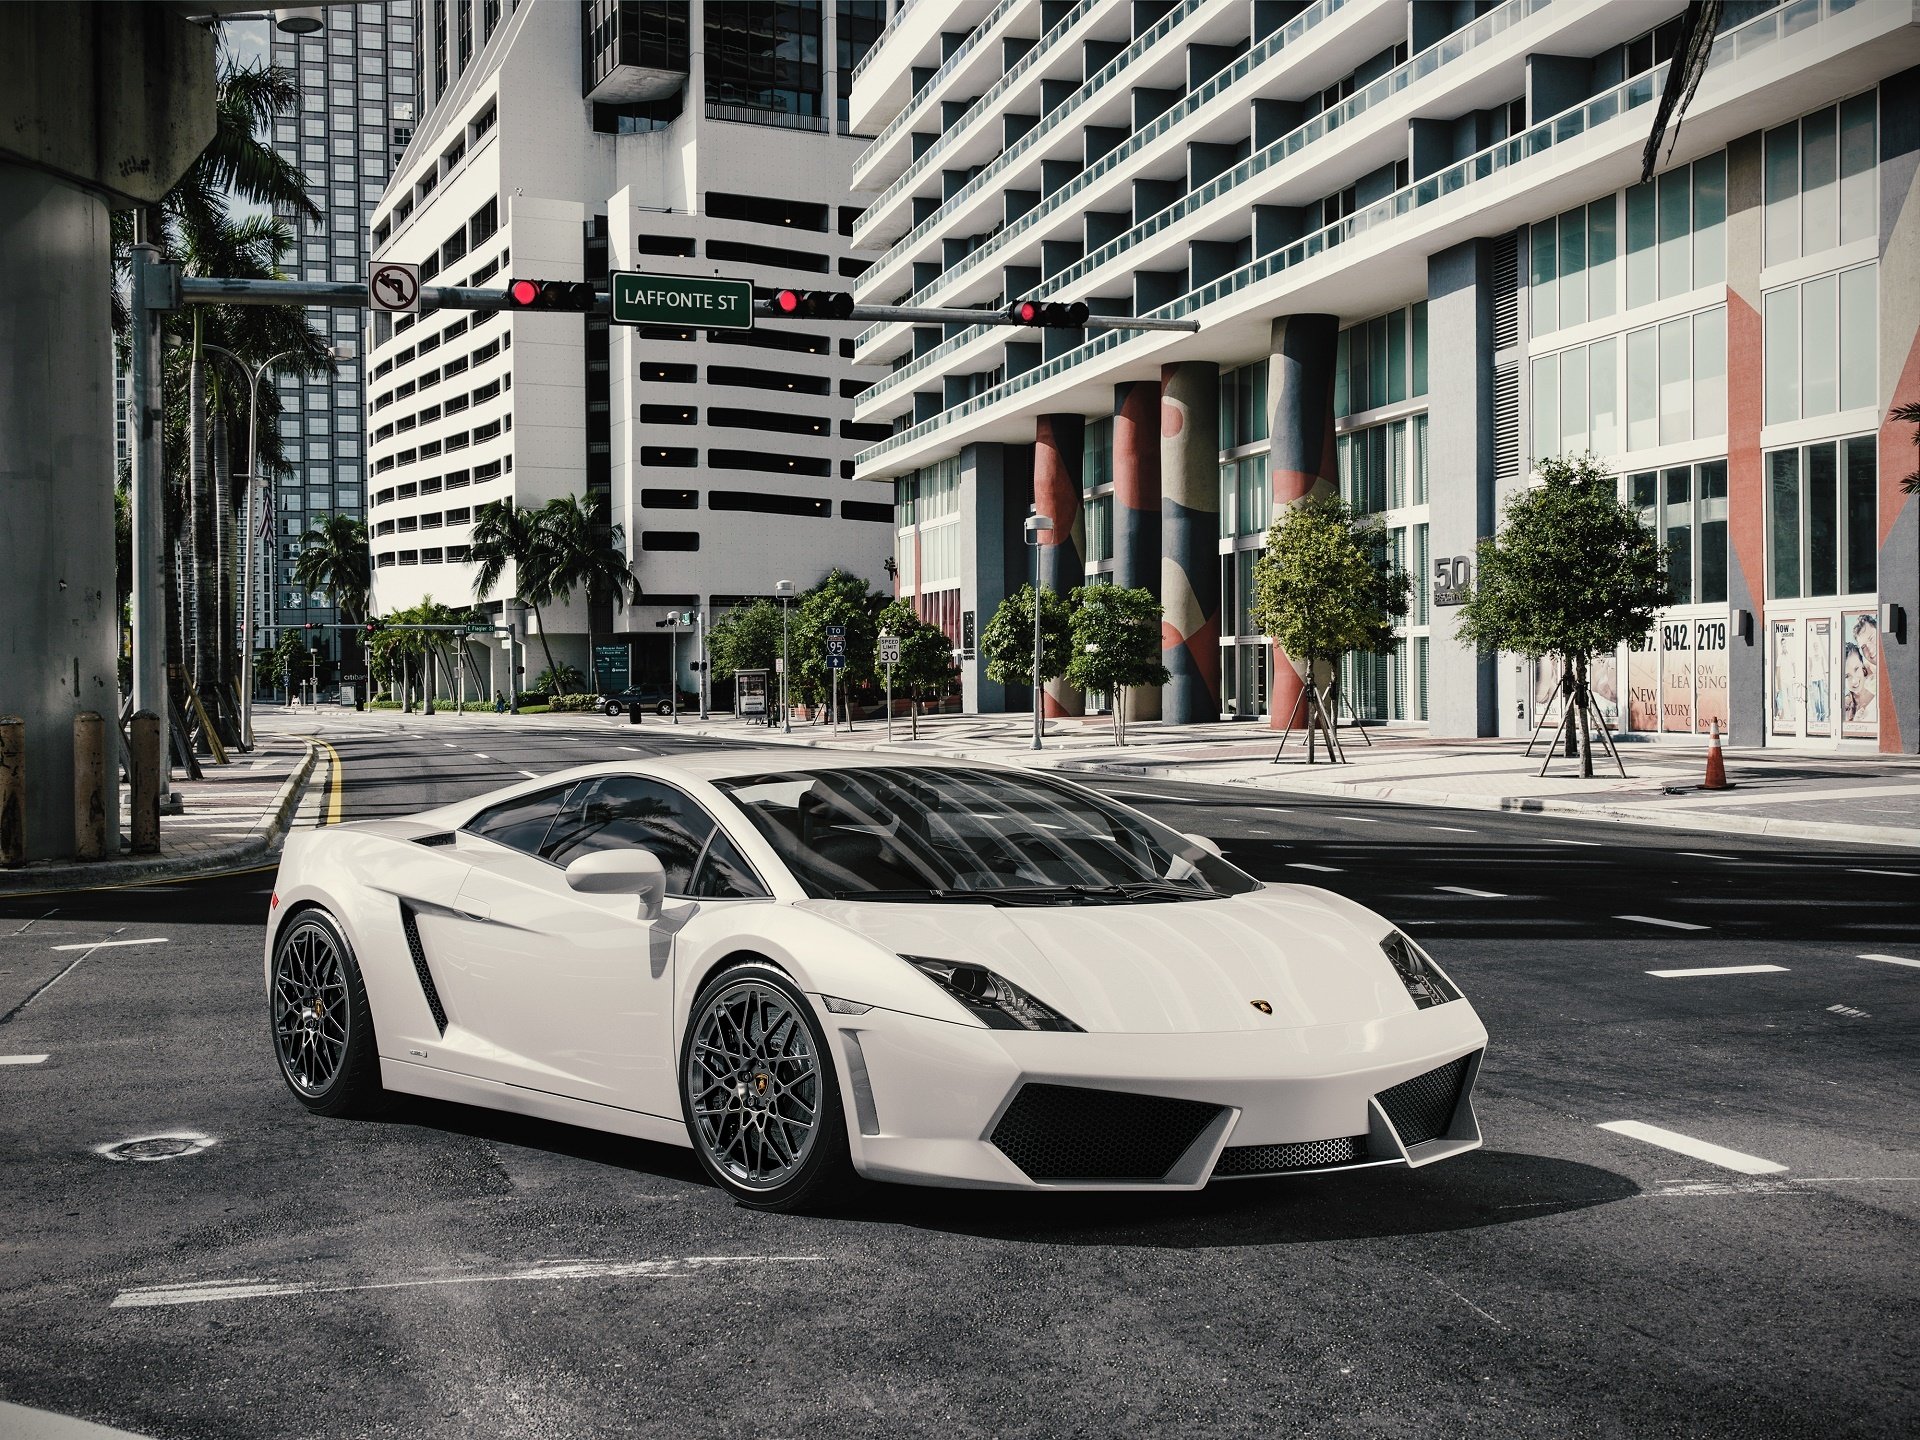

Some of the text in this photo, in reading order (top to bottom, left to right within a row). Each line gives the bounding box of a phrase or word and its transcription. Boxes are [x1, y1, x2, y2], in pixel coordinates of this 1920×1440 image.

[624, 289, 739, 311] LAFFONTE ST
[1433, 555, 1471, 591] 50
[1697, 622, 1726, 651] 2179
[829, 641, 843, 653] 95
[881, 650, 899, 661] 30
[1671, 674, 1727, 689] LEASING
[1631, 687, 1658, 702] NEW
[1644, 702, 1691, 716] LUXURY
